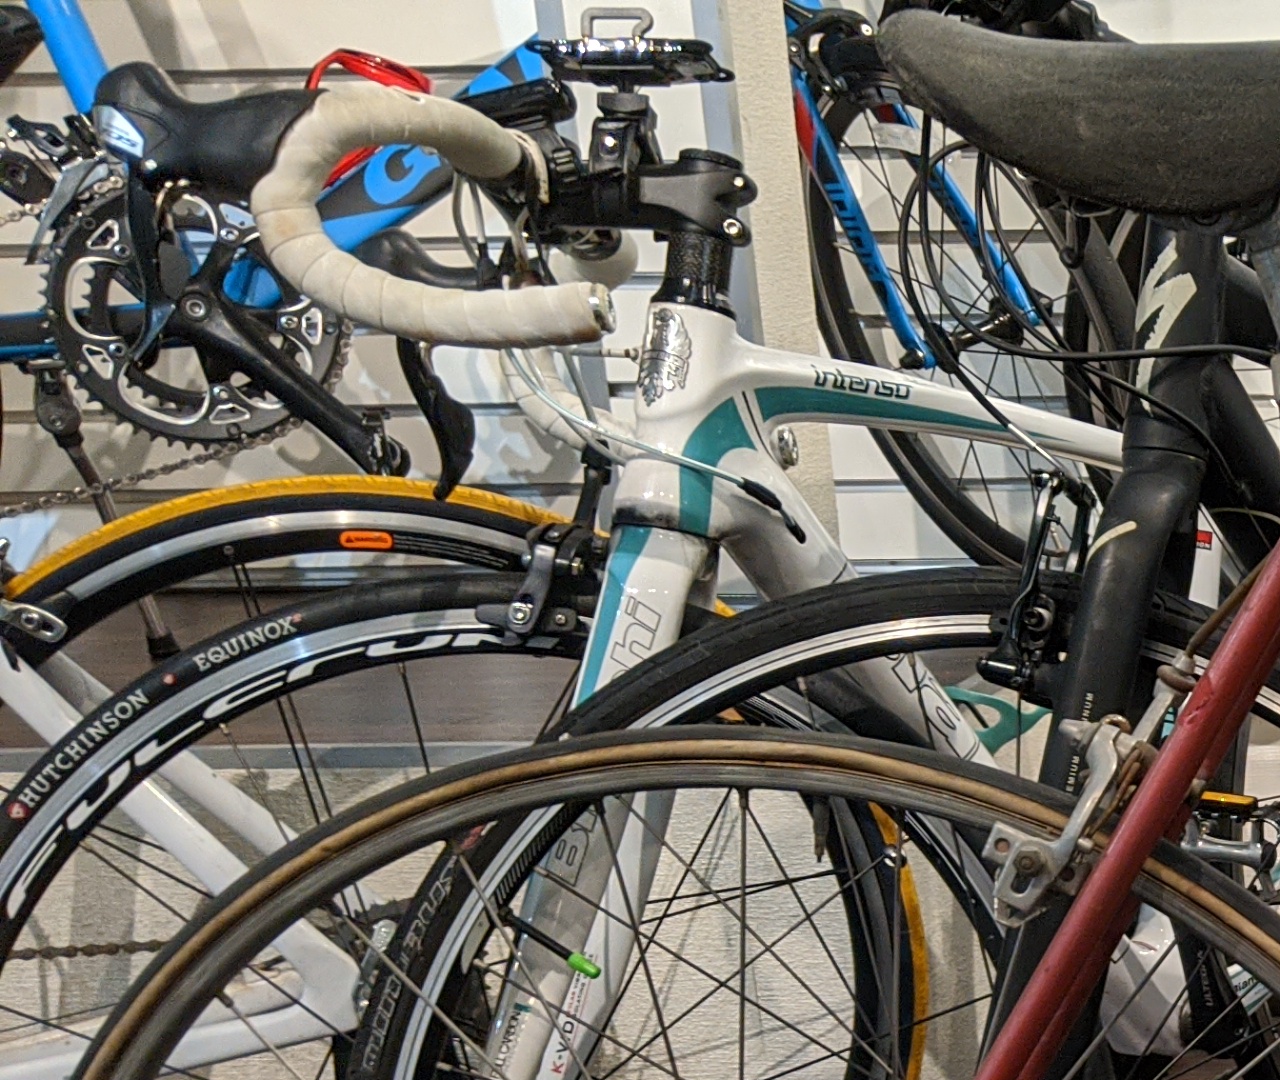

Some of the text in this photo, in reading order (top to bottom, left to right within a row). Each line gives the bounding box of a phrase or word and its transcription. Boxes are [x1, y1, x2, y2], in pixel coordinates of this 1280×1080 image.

[810, 364, 913, 400] intenso
[191, 616, 298, 672] EQUINOX
[17, 687, 150, 808] HUTCHINSON
